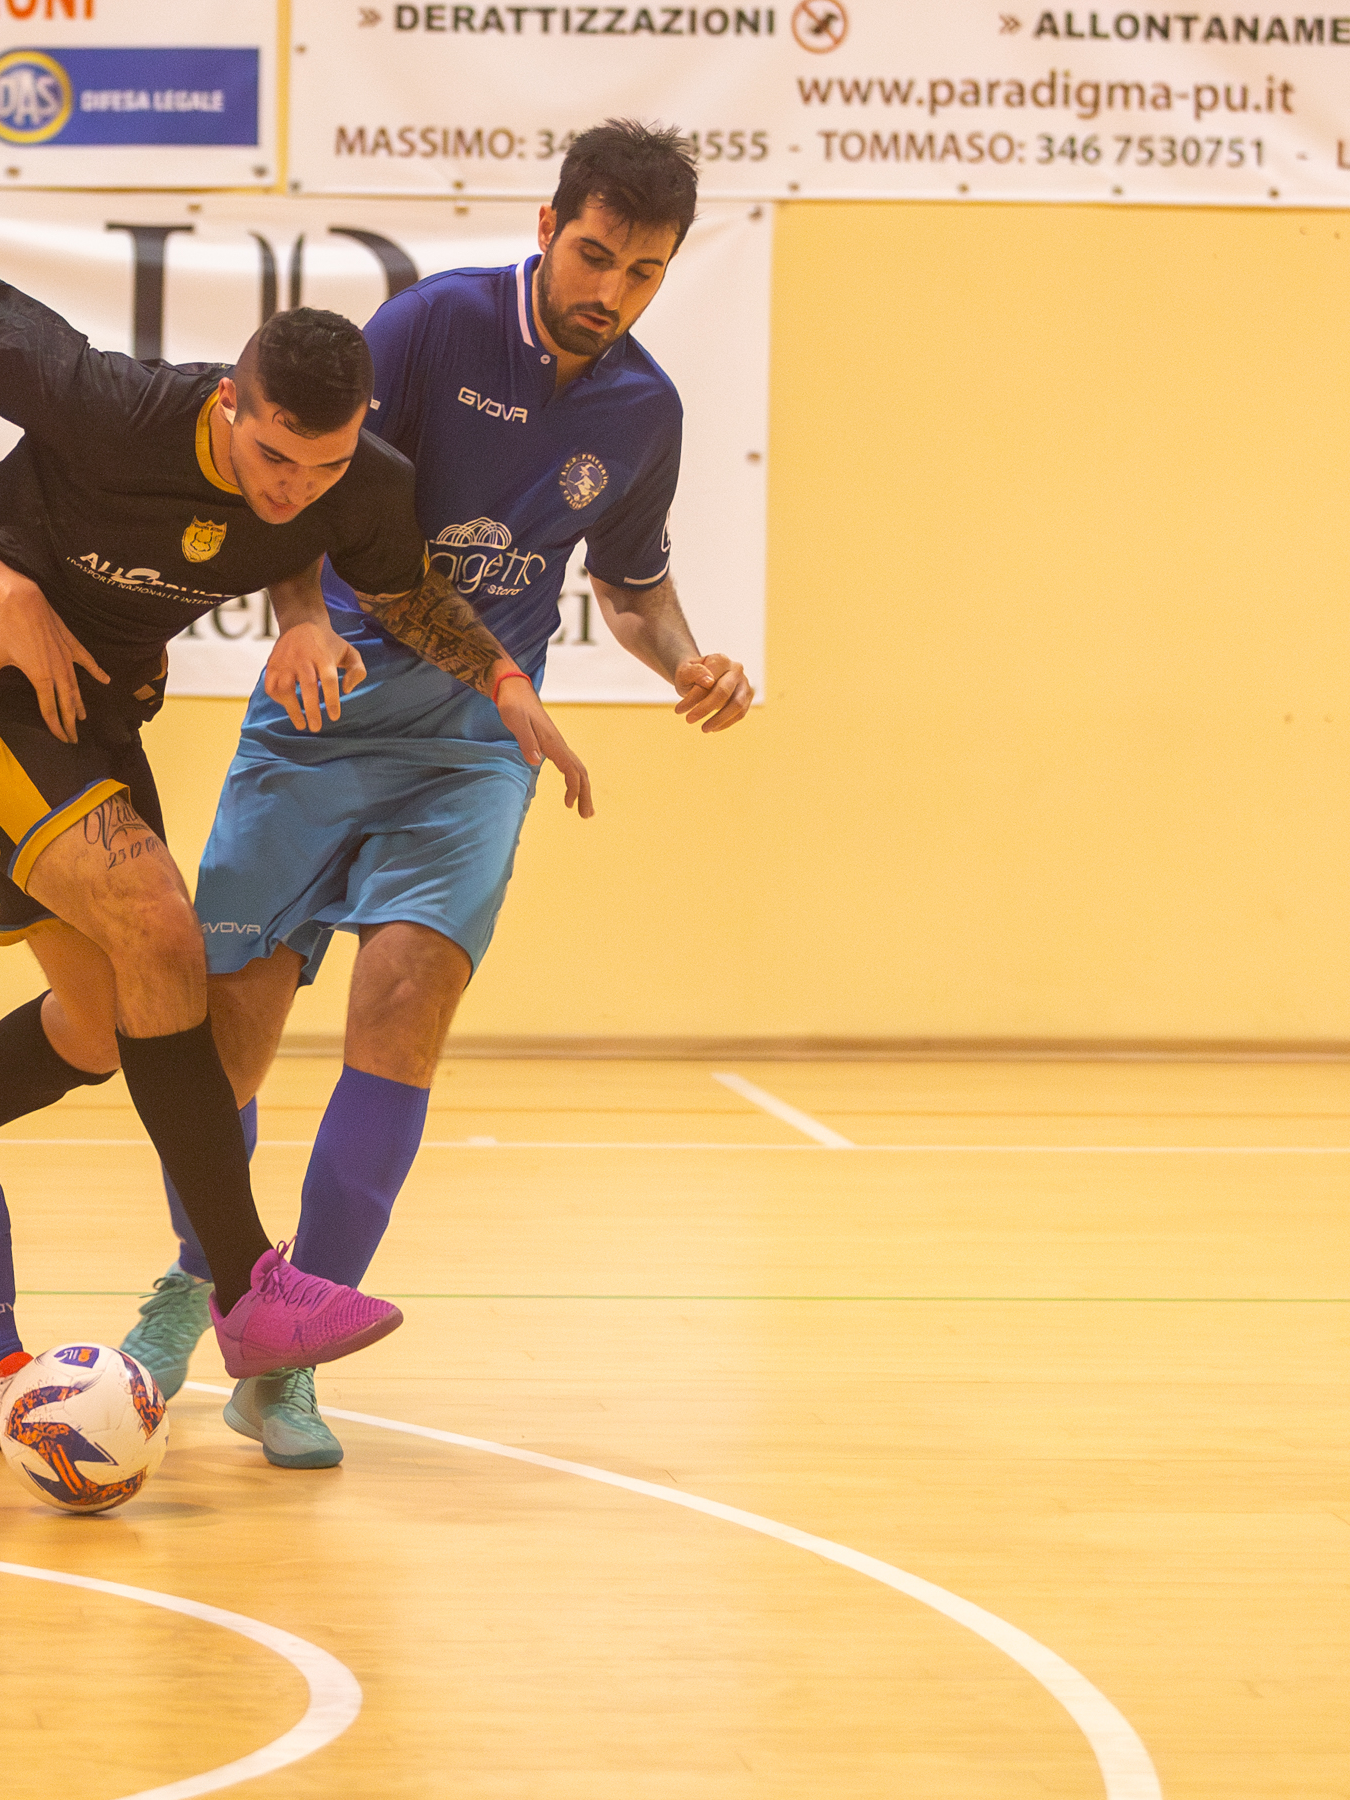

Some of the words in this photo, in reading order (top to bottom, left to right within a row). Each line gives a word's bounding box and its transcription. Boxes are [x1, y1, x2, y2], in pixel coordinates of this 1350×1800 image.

[394, 3, 777, 37] DERATTIZZAZIONI
[152, 90, 226, 113] LEGALE
[796, 68, 1296, 120] www.paradigma-pu.it
[334, 125, 527, 160] MASSIMO:
[817, 129, 1026, 165] TOMMASO:
[1035, 133, 1102, 165] 346
[1114, 134, 1265, 169] 7530751
